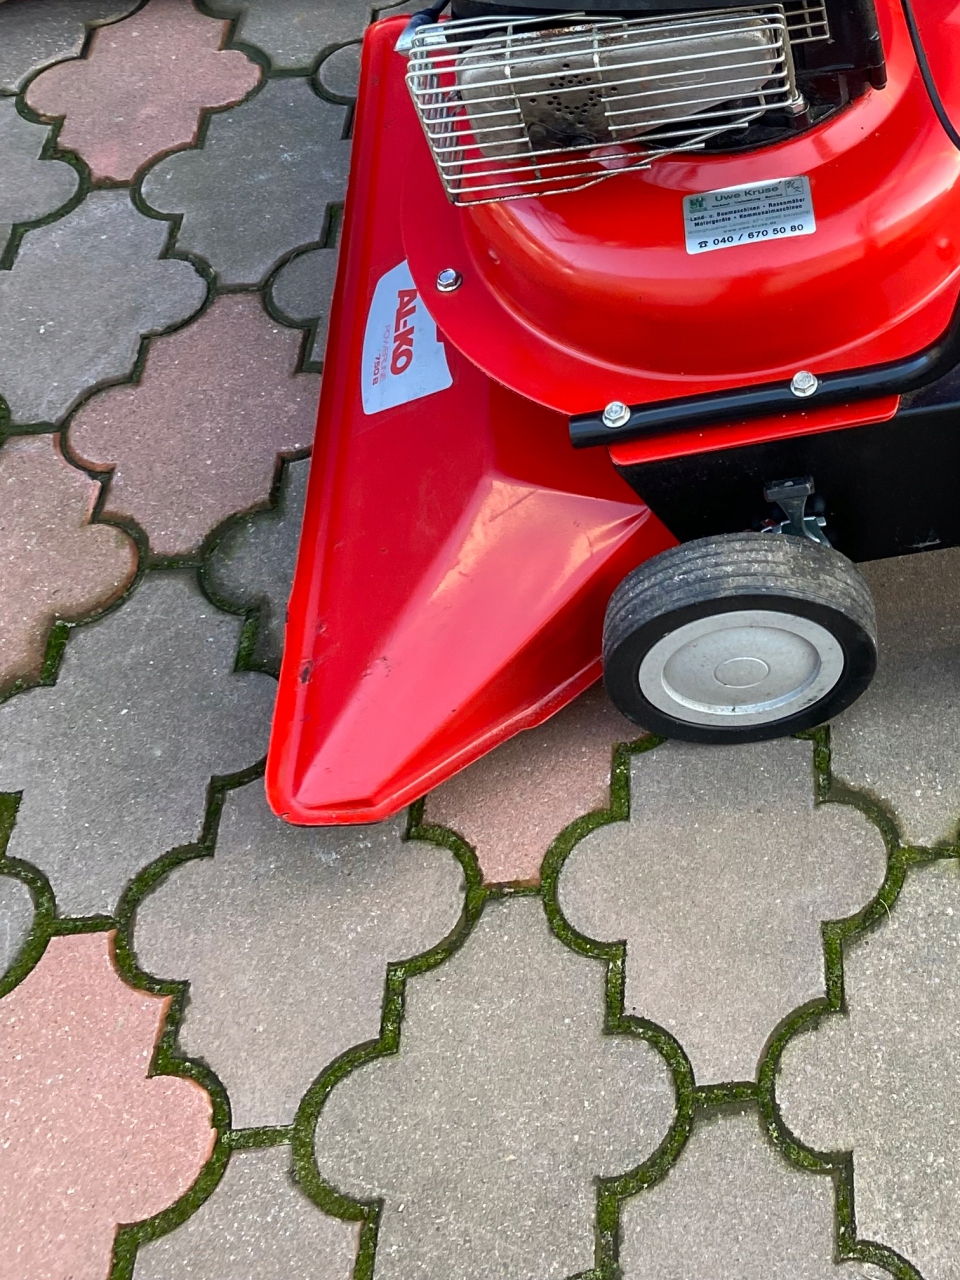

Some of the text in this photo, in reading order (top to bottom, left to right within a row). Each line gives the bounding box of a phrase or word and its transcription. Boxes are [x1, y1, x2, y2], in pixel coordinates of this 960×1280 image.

[715, 185, 779, 202] Uwe Kruse
[713, 235, 734, 246] 040
[747, 229, 769, 239] 670
[772, 226, 786, 235] 50
[790, 223, 804, 232] 80
[391, 290, 418, 375] AL-KO
